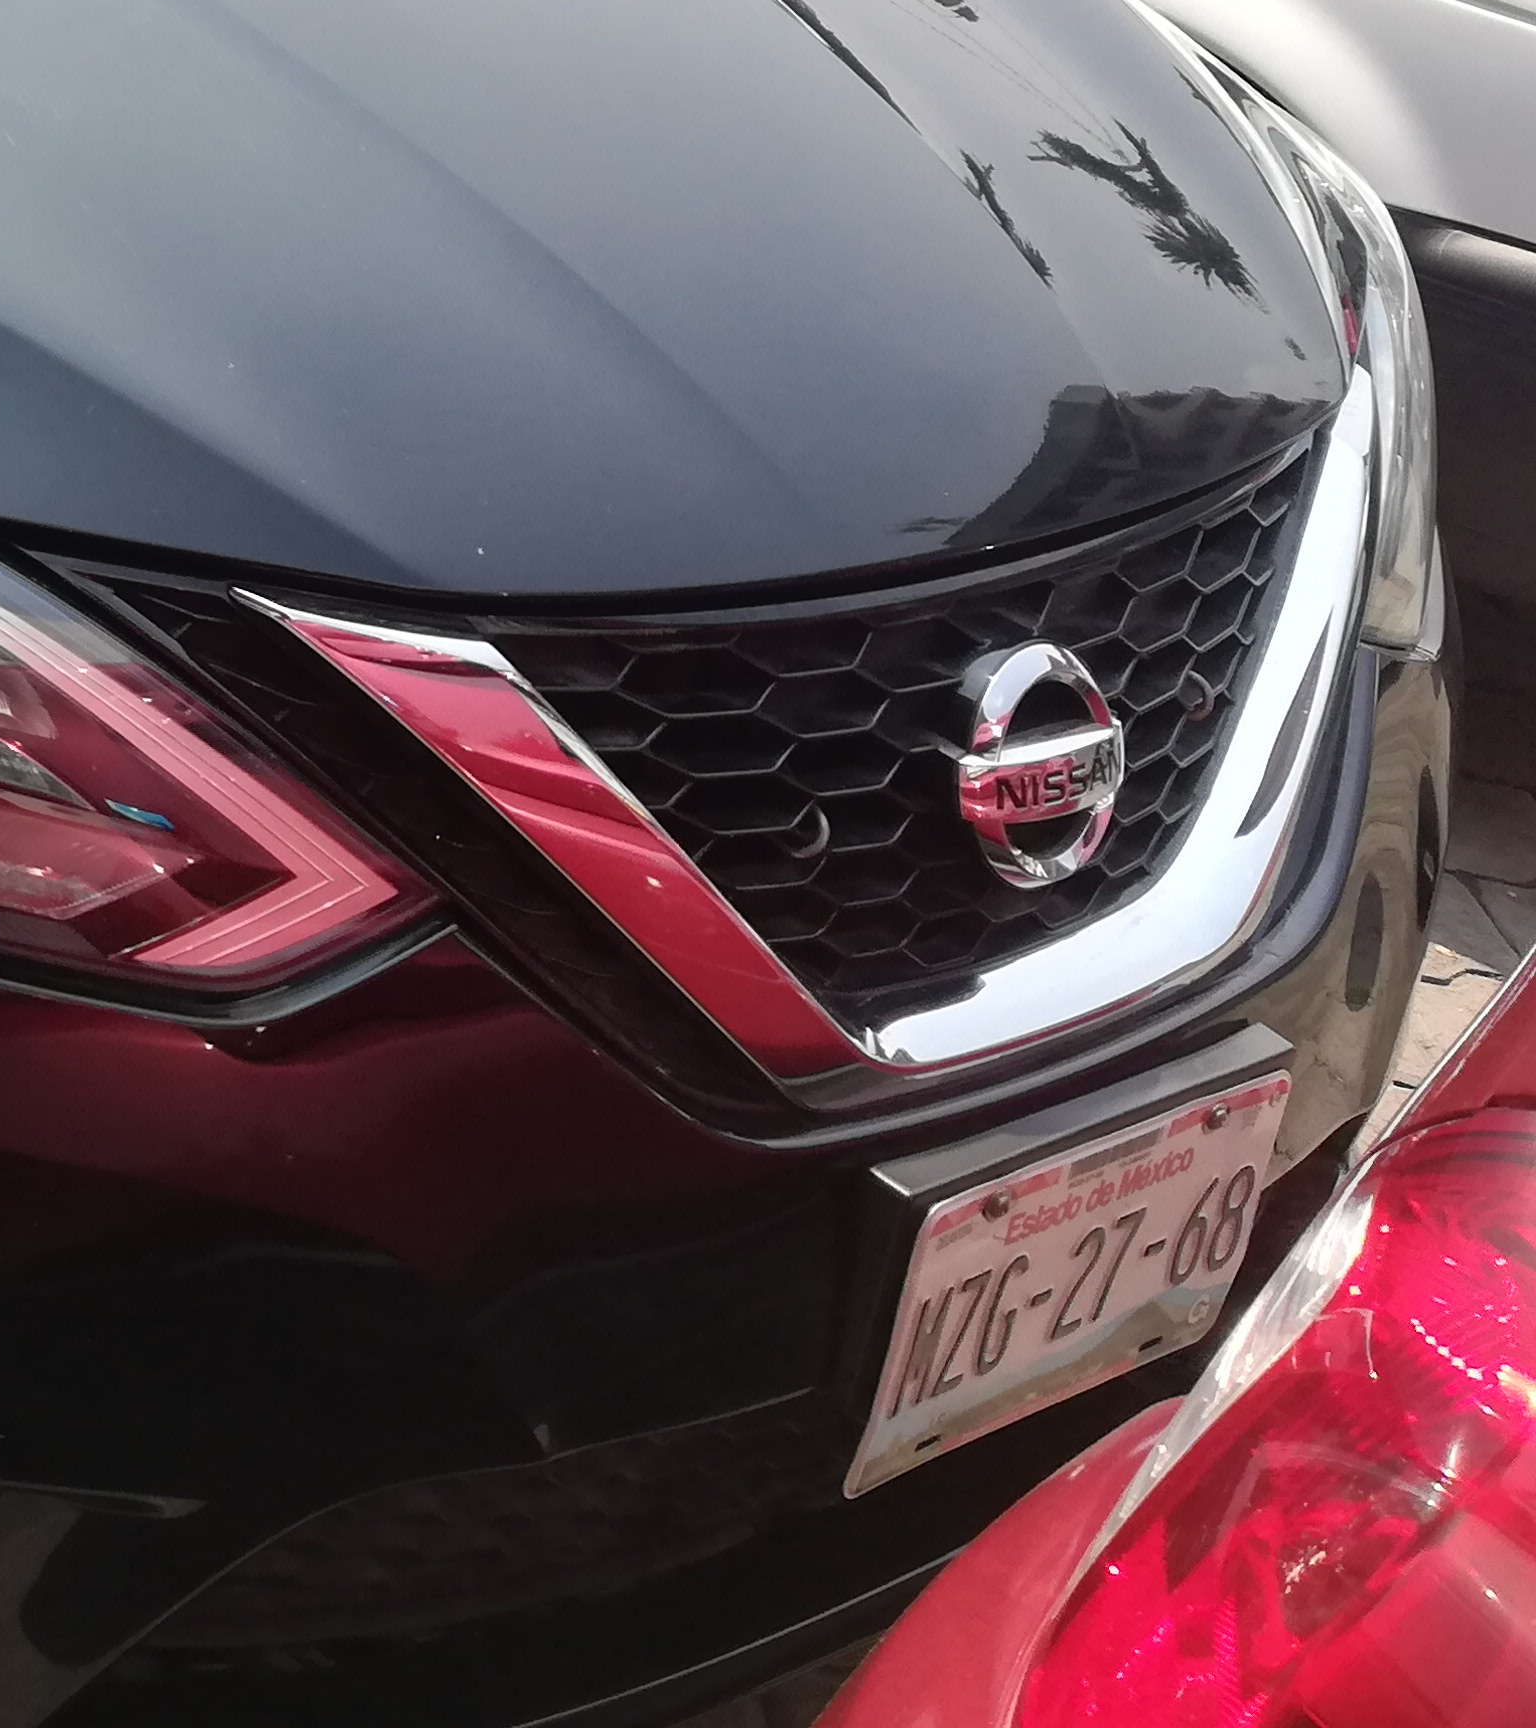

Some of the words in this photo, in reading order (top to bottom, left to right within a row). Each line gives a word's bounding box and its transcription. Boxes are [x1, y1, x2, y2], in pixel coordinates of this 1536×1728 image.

[994, 746, 1119, 810] NISSAN
[1004, 1189, 1083, 1246] Estado
[1085, 1179, 1116, 1213] de
[1117, 1147, 1195, 1201] México
[886, 1164, 1257, 1419] MZG-27-68
